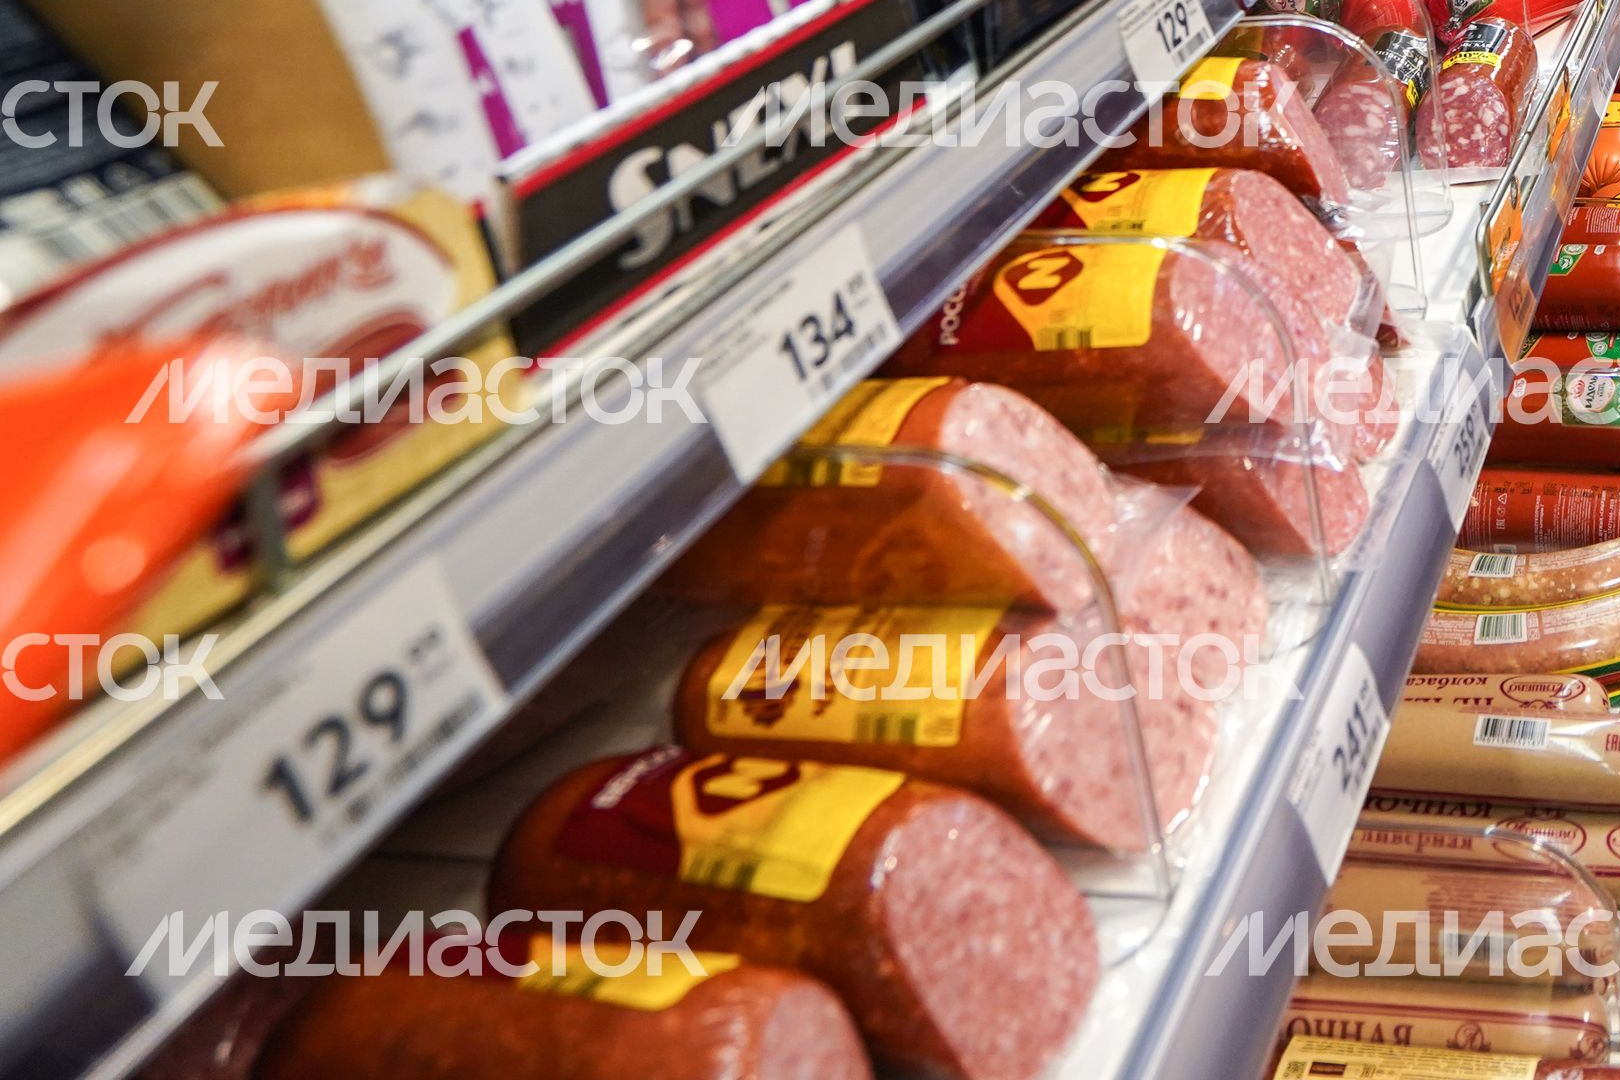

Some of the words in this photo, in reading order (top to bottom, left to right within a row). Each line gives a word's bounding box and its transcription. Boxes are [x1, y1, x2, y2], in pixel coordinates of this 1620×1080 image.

[1156, 1, 1189, 54] 129
[779, 288, 855, 381] 134
[262, 664, 411, 822] 129
